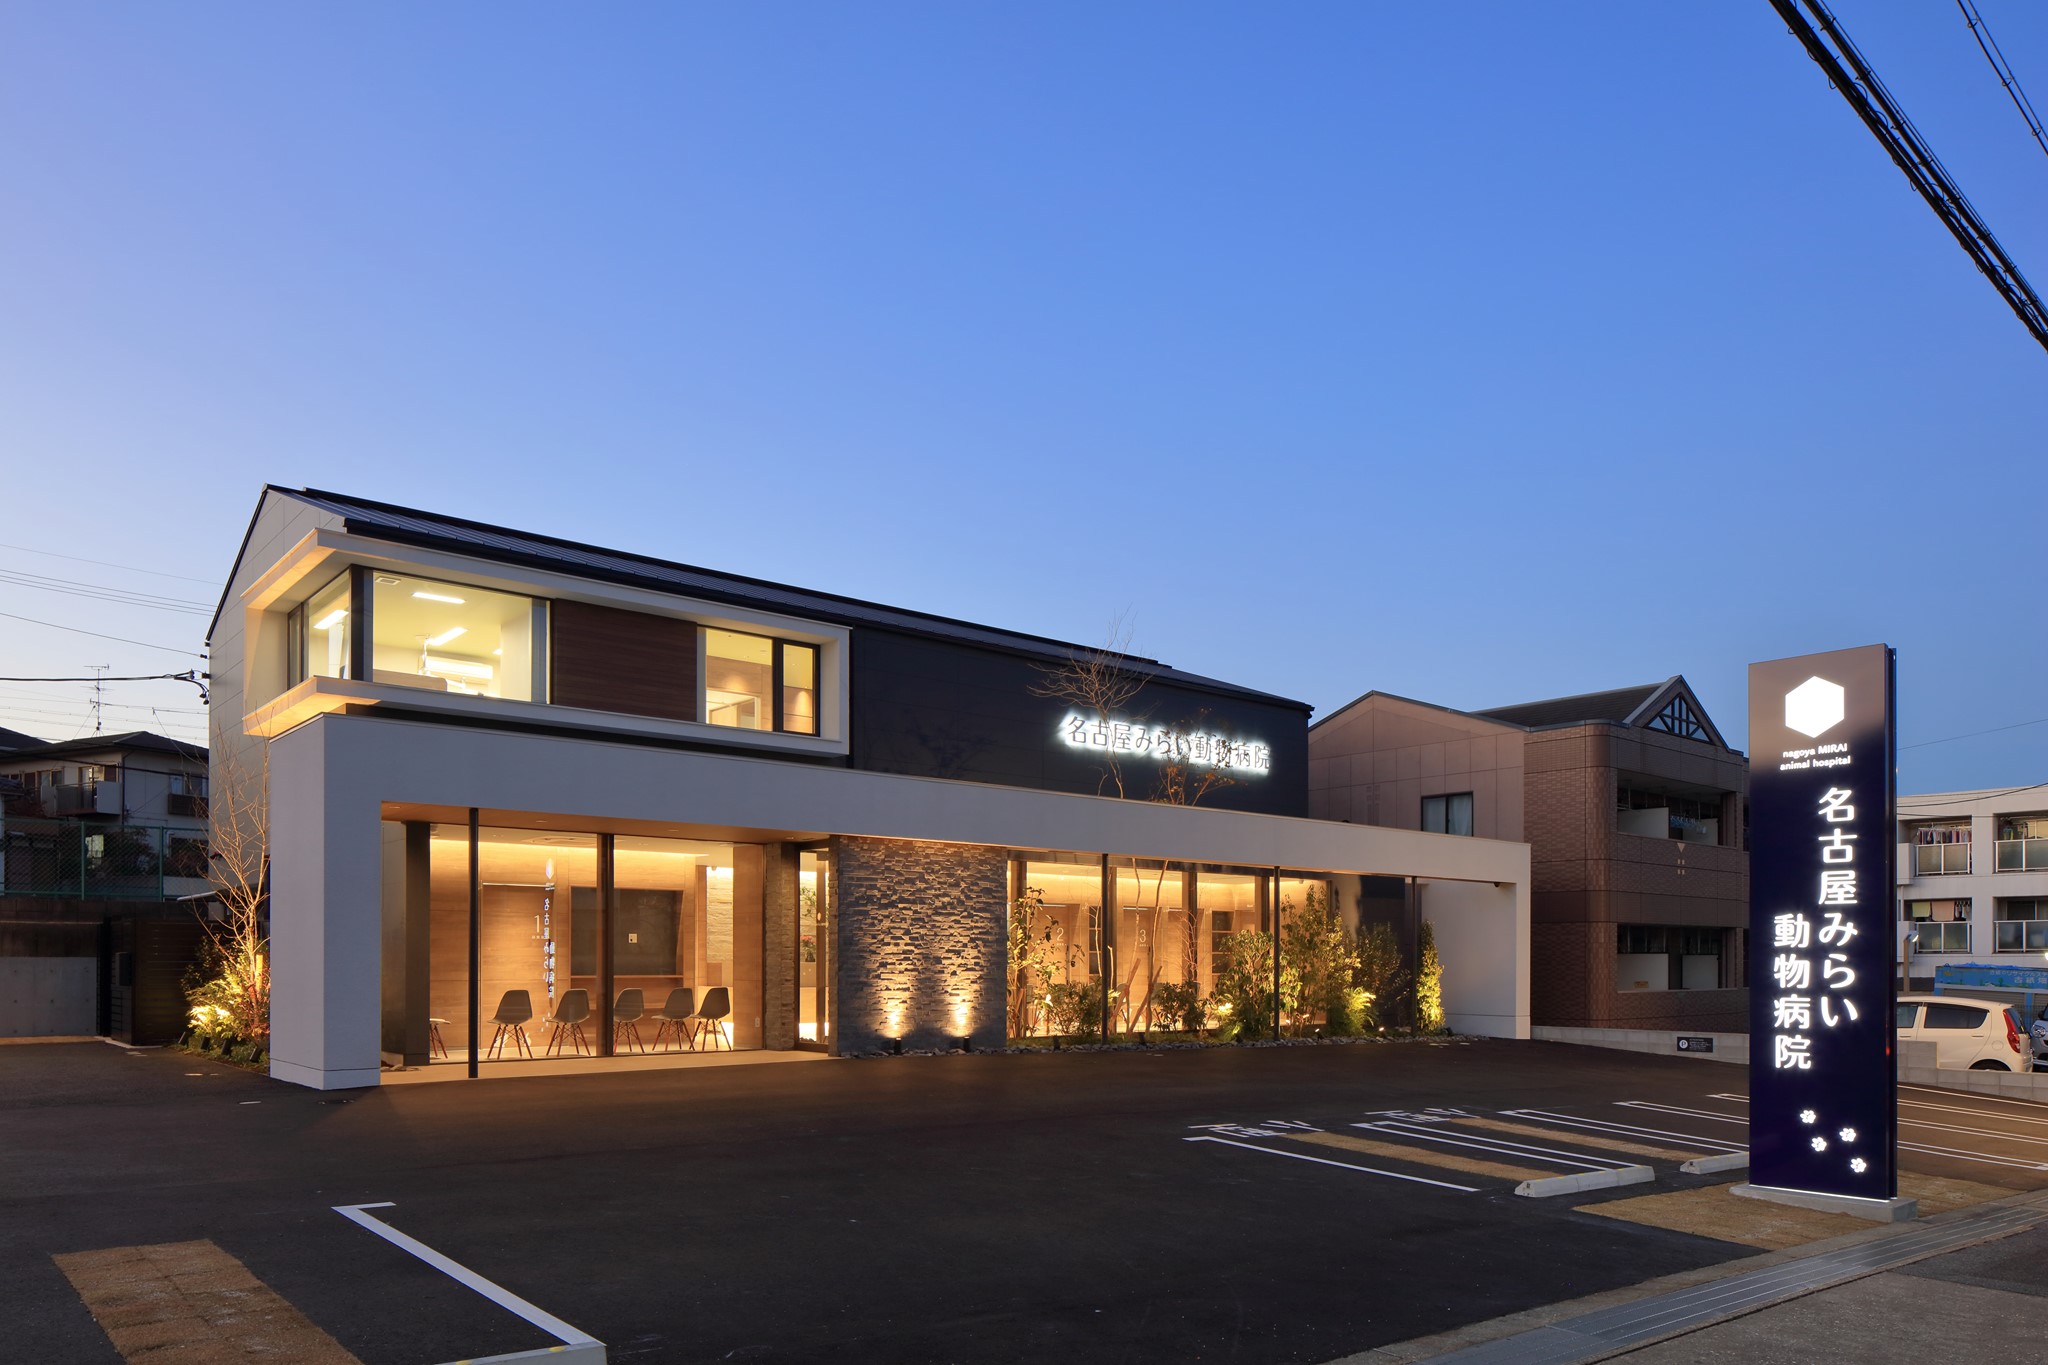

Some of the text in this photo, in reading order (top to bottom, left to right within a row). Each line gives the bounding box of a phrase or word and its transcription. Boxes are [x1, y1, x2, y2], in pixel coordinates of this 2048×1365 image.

[1067, 715, 1271, 770] 名古屋みらい動物病院
[1782, 743, 1848, 760] nagoya MIRAI
[1780, 755, 1851, 771] animal hospital
[1818, 787, 1859, 1028] 名古屋みらい
[534, 914, 540, 933] 1
[1056, 927, 1064, 942] 2
[1139, 929, 1147, 943] 3
[1773, 913, 1812, 1070] 動物病院
